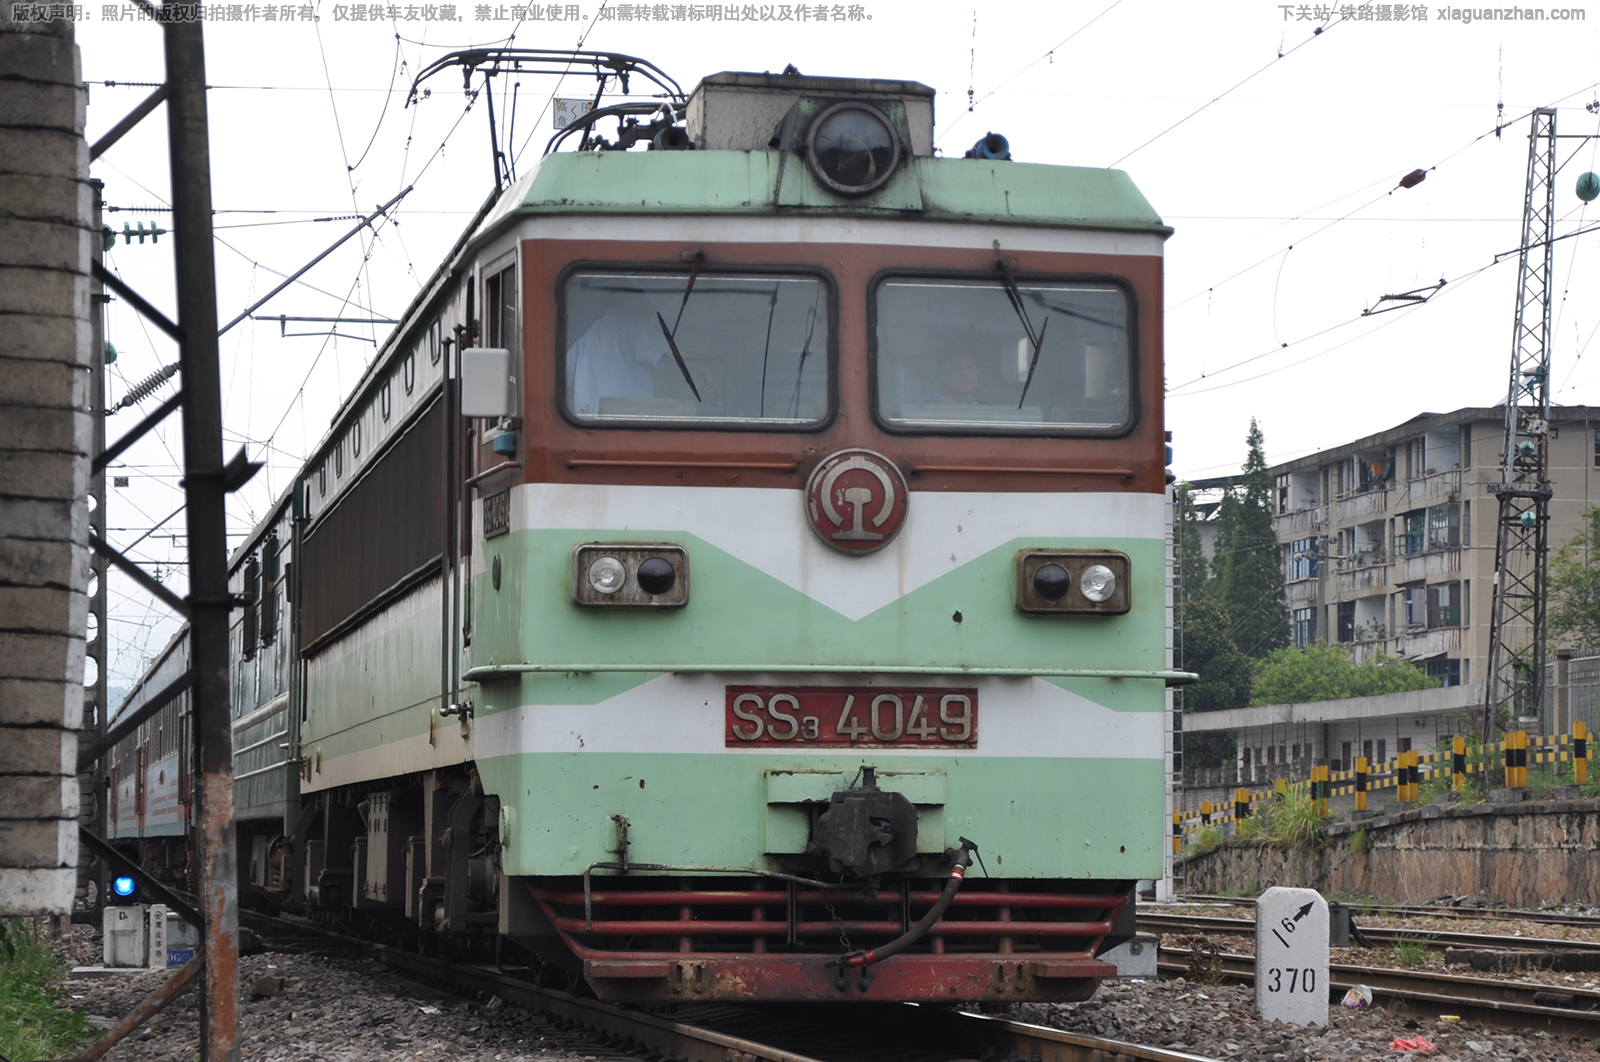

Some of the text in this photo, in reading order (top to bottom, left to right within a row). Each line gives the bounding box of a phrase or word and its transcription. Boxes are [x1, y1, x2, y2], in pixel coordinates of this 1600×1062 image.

[732, 692, 972, 742] SS3 4049
[1268, 968, 1316, 993] 370
